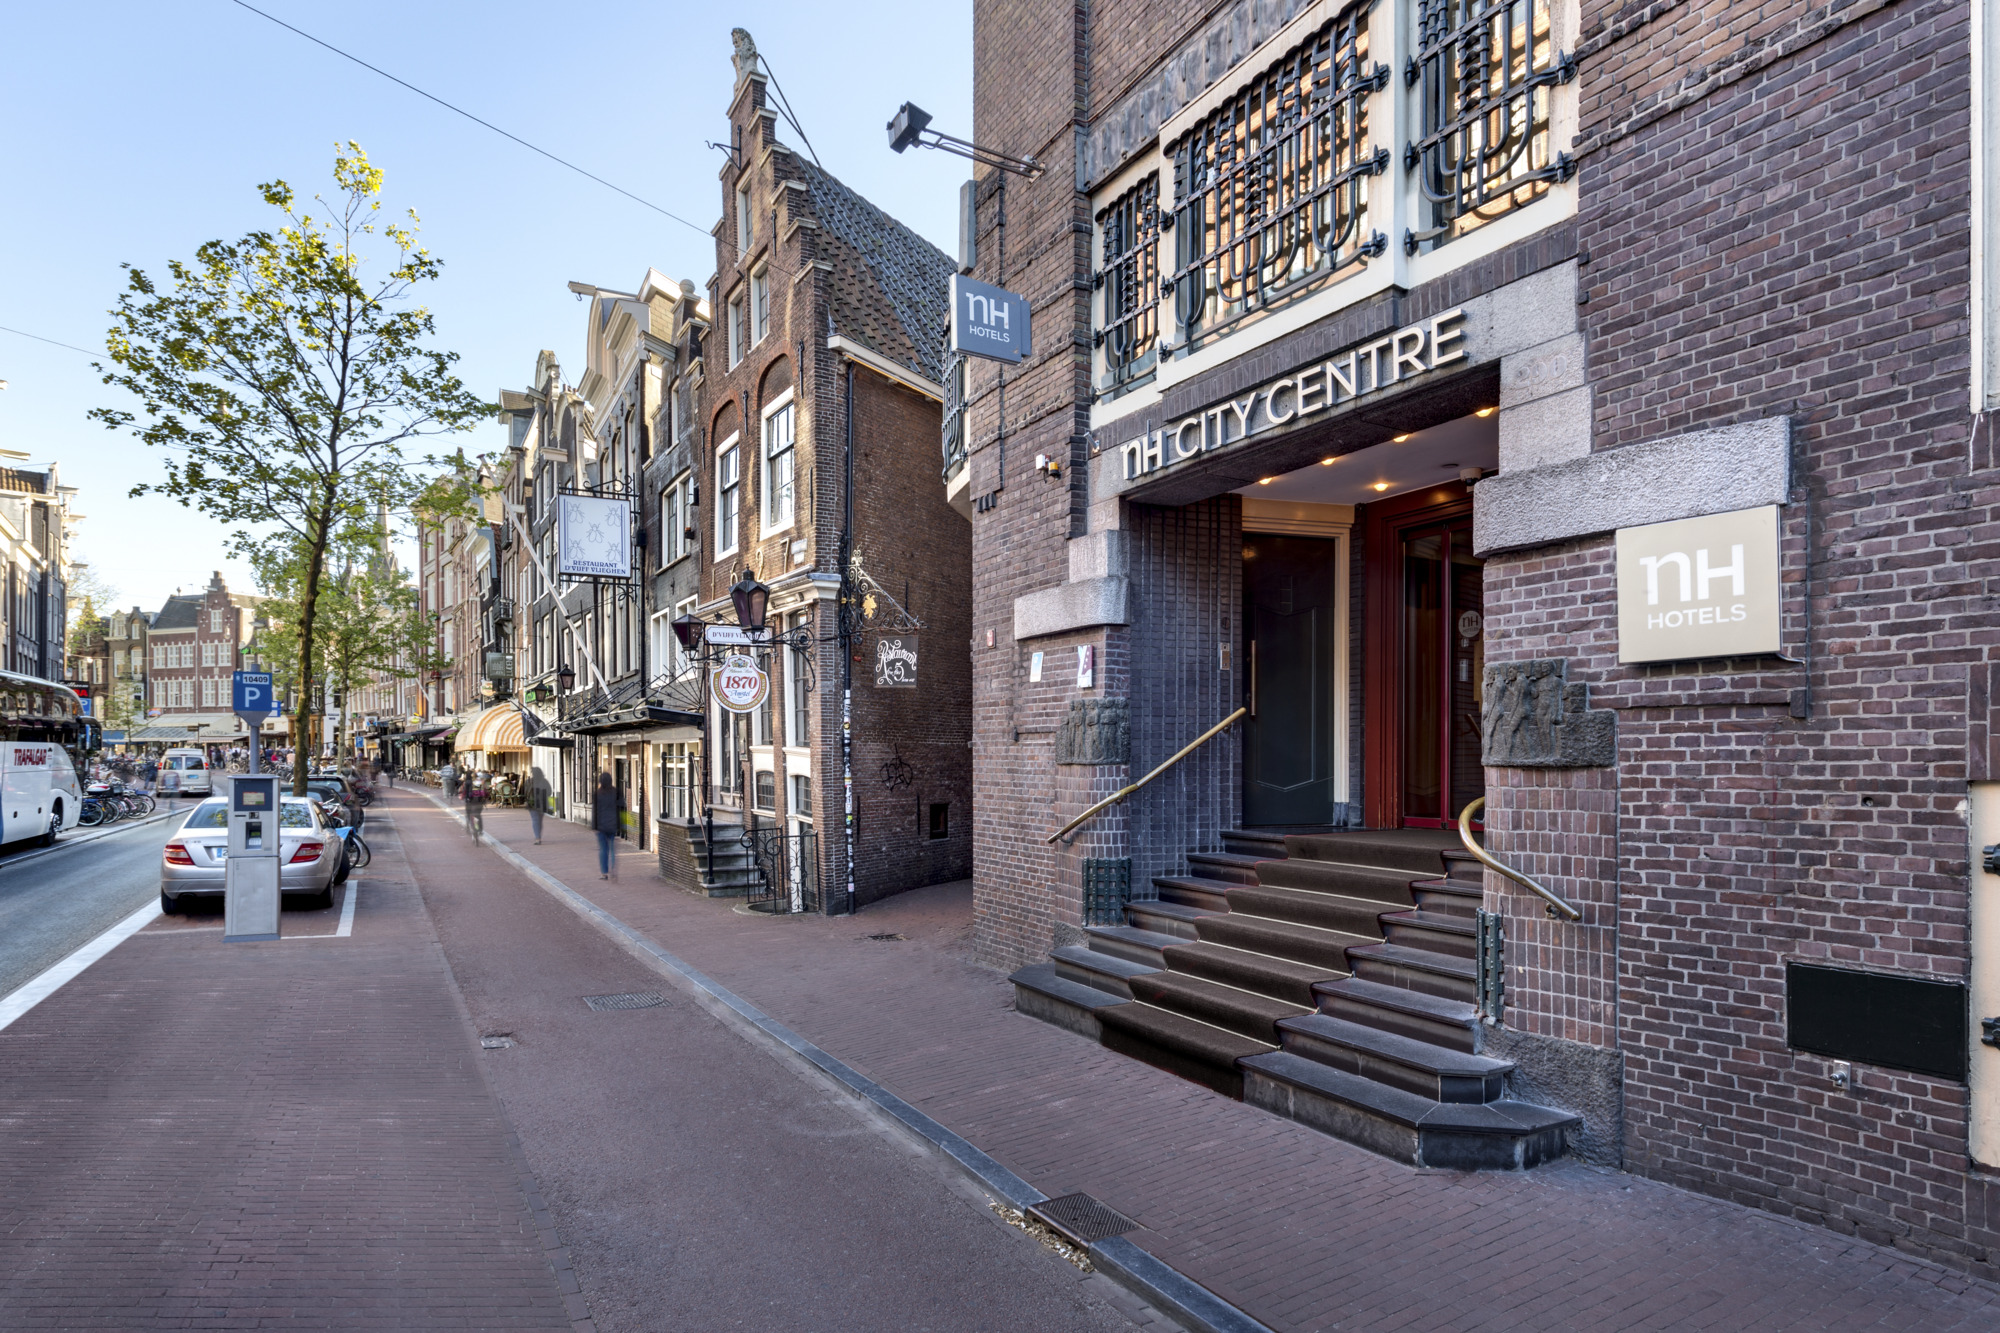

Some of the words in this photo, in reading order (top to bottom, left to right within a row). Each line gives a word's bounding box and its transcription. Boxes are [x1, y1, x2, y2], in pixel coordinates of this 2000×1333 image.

[969, 325, 1010, 343] HOTELS
[1176, 392, 1261, 459] CITY
[1266, 308, 1469, 426] CENTRE
[573, 560, 618, 568] RESTAURANT
[591, 567, 626, 575] VLIEGHEN
[1648, 604, 1747, 630] HOTELS
[724, 676, 757, 689] 1870
[245, 687, 260, 708] P
[14, 748, 47, 766] TRAFALGAR
